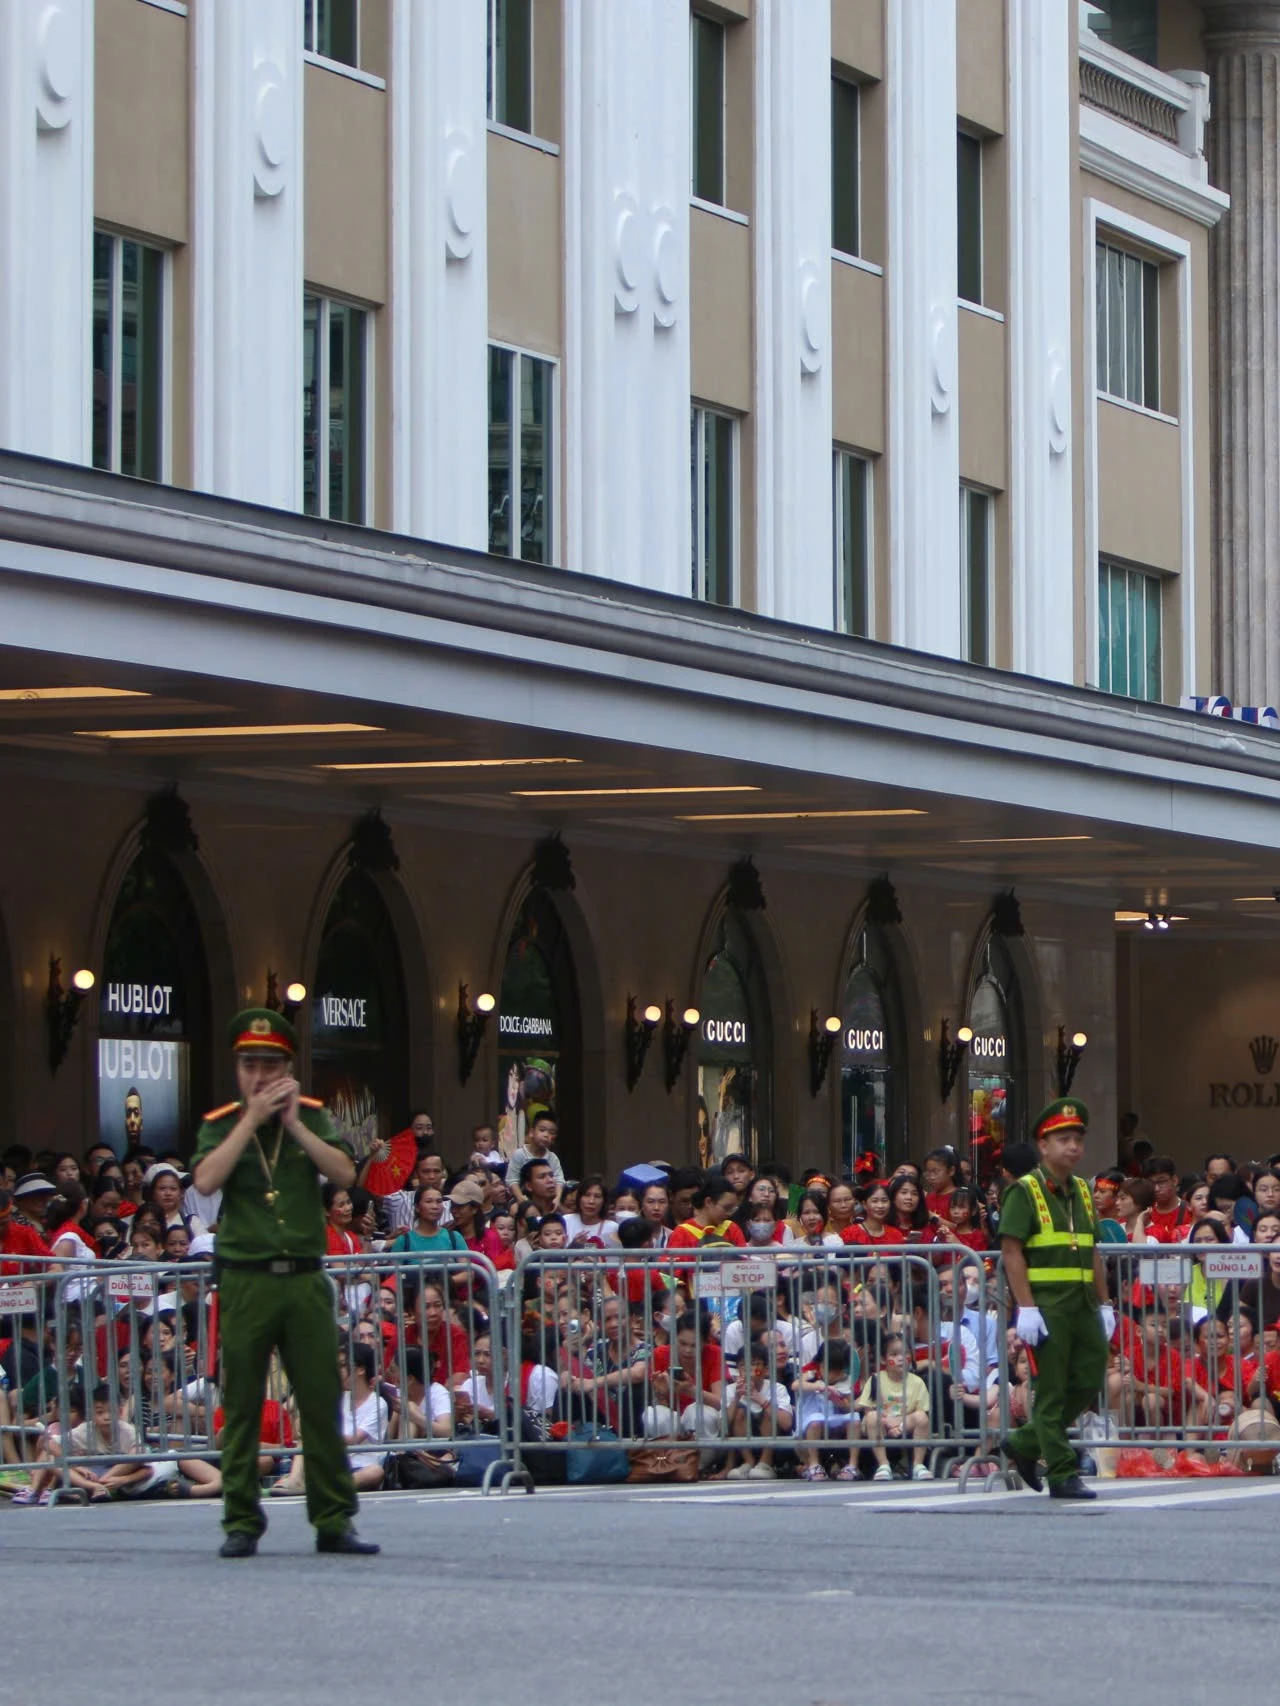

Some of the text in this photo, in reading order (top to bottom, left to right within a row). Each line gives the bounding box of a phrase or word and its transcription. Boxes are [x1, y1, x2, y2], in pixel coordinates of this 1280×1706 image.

[108, 983, 172, 1014] HUBLOT
[323, 997, 366, 1027] VERSACE
[707, 1019, 745, 1043] GUCCI
[848, 1028, 883, 1050] GUCCI
[974, 1036, 1005, 1057] GUCCI
[732, 1273, 765, 1283] STOP
